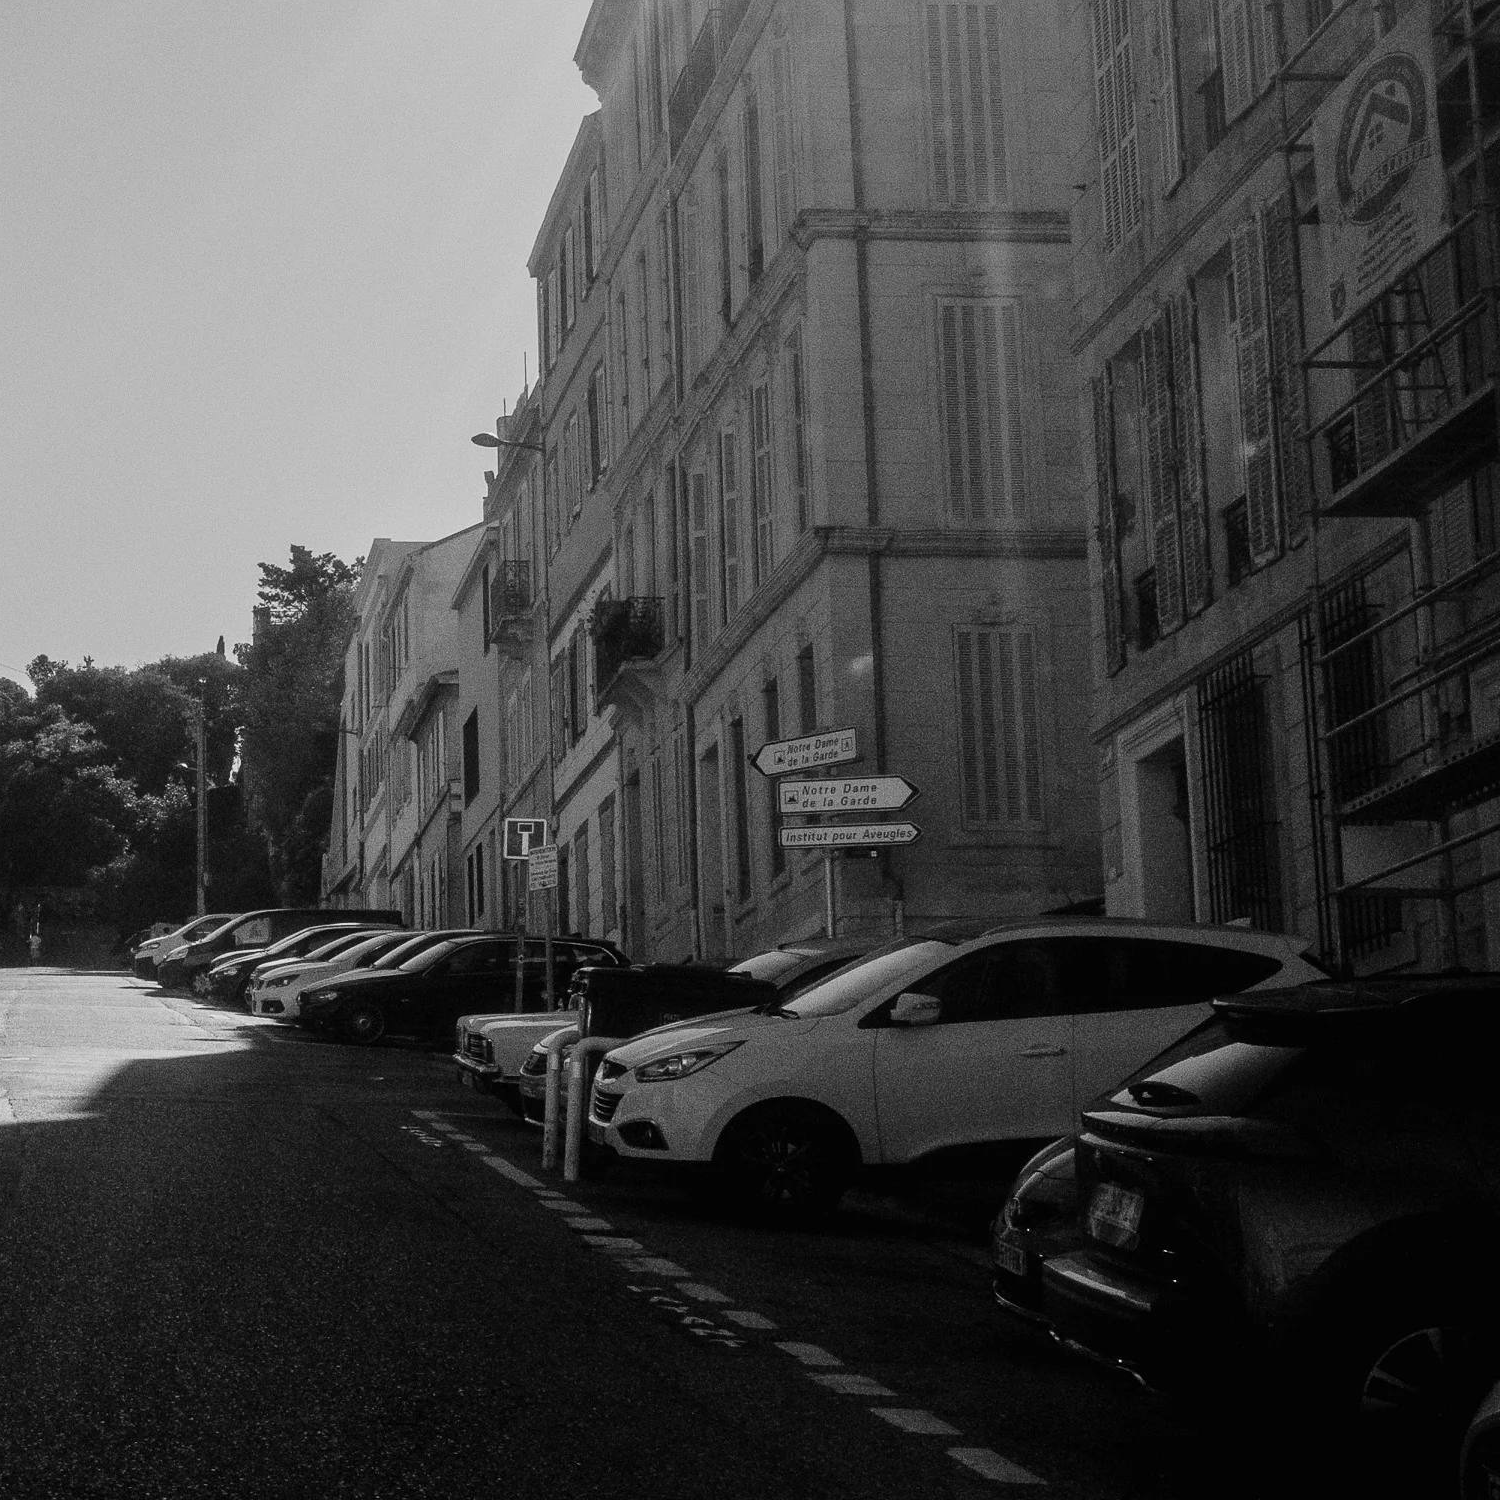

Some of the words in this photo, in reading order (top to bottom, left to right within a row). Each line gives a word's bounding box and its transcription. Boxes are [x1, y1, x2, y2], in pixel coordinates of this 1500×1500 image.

[787, 743, 811, 755] Notre
[815, 738, 839, 749] Dame
[787, 756, 798, 767] de
[802, 754, 809, 764] la
[813, 749, 839, 762] Garde
[802, 785, 836, 795] Notre
[843, 783, 877, 794] Dame
[802, 798, 816, 808] de
[823, 797, 834, 807] la
[841, 795, 877, 806] Garde
[786, 832, 828, 842] Institut
[832, 831, 857, 842] pour
[862, 829, 914, 840] Aveugles
